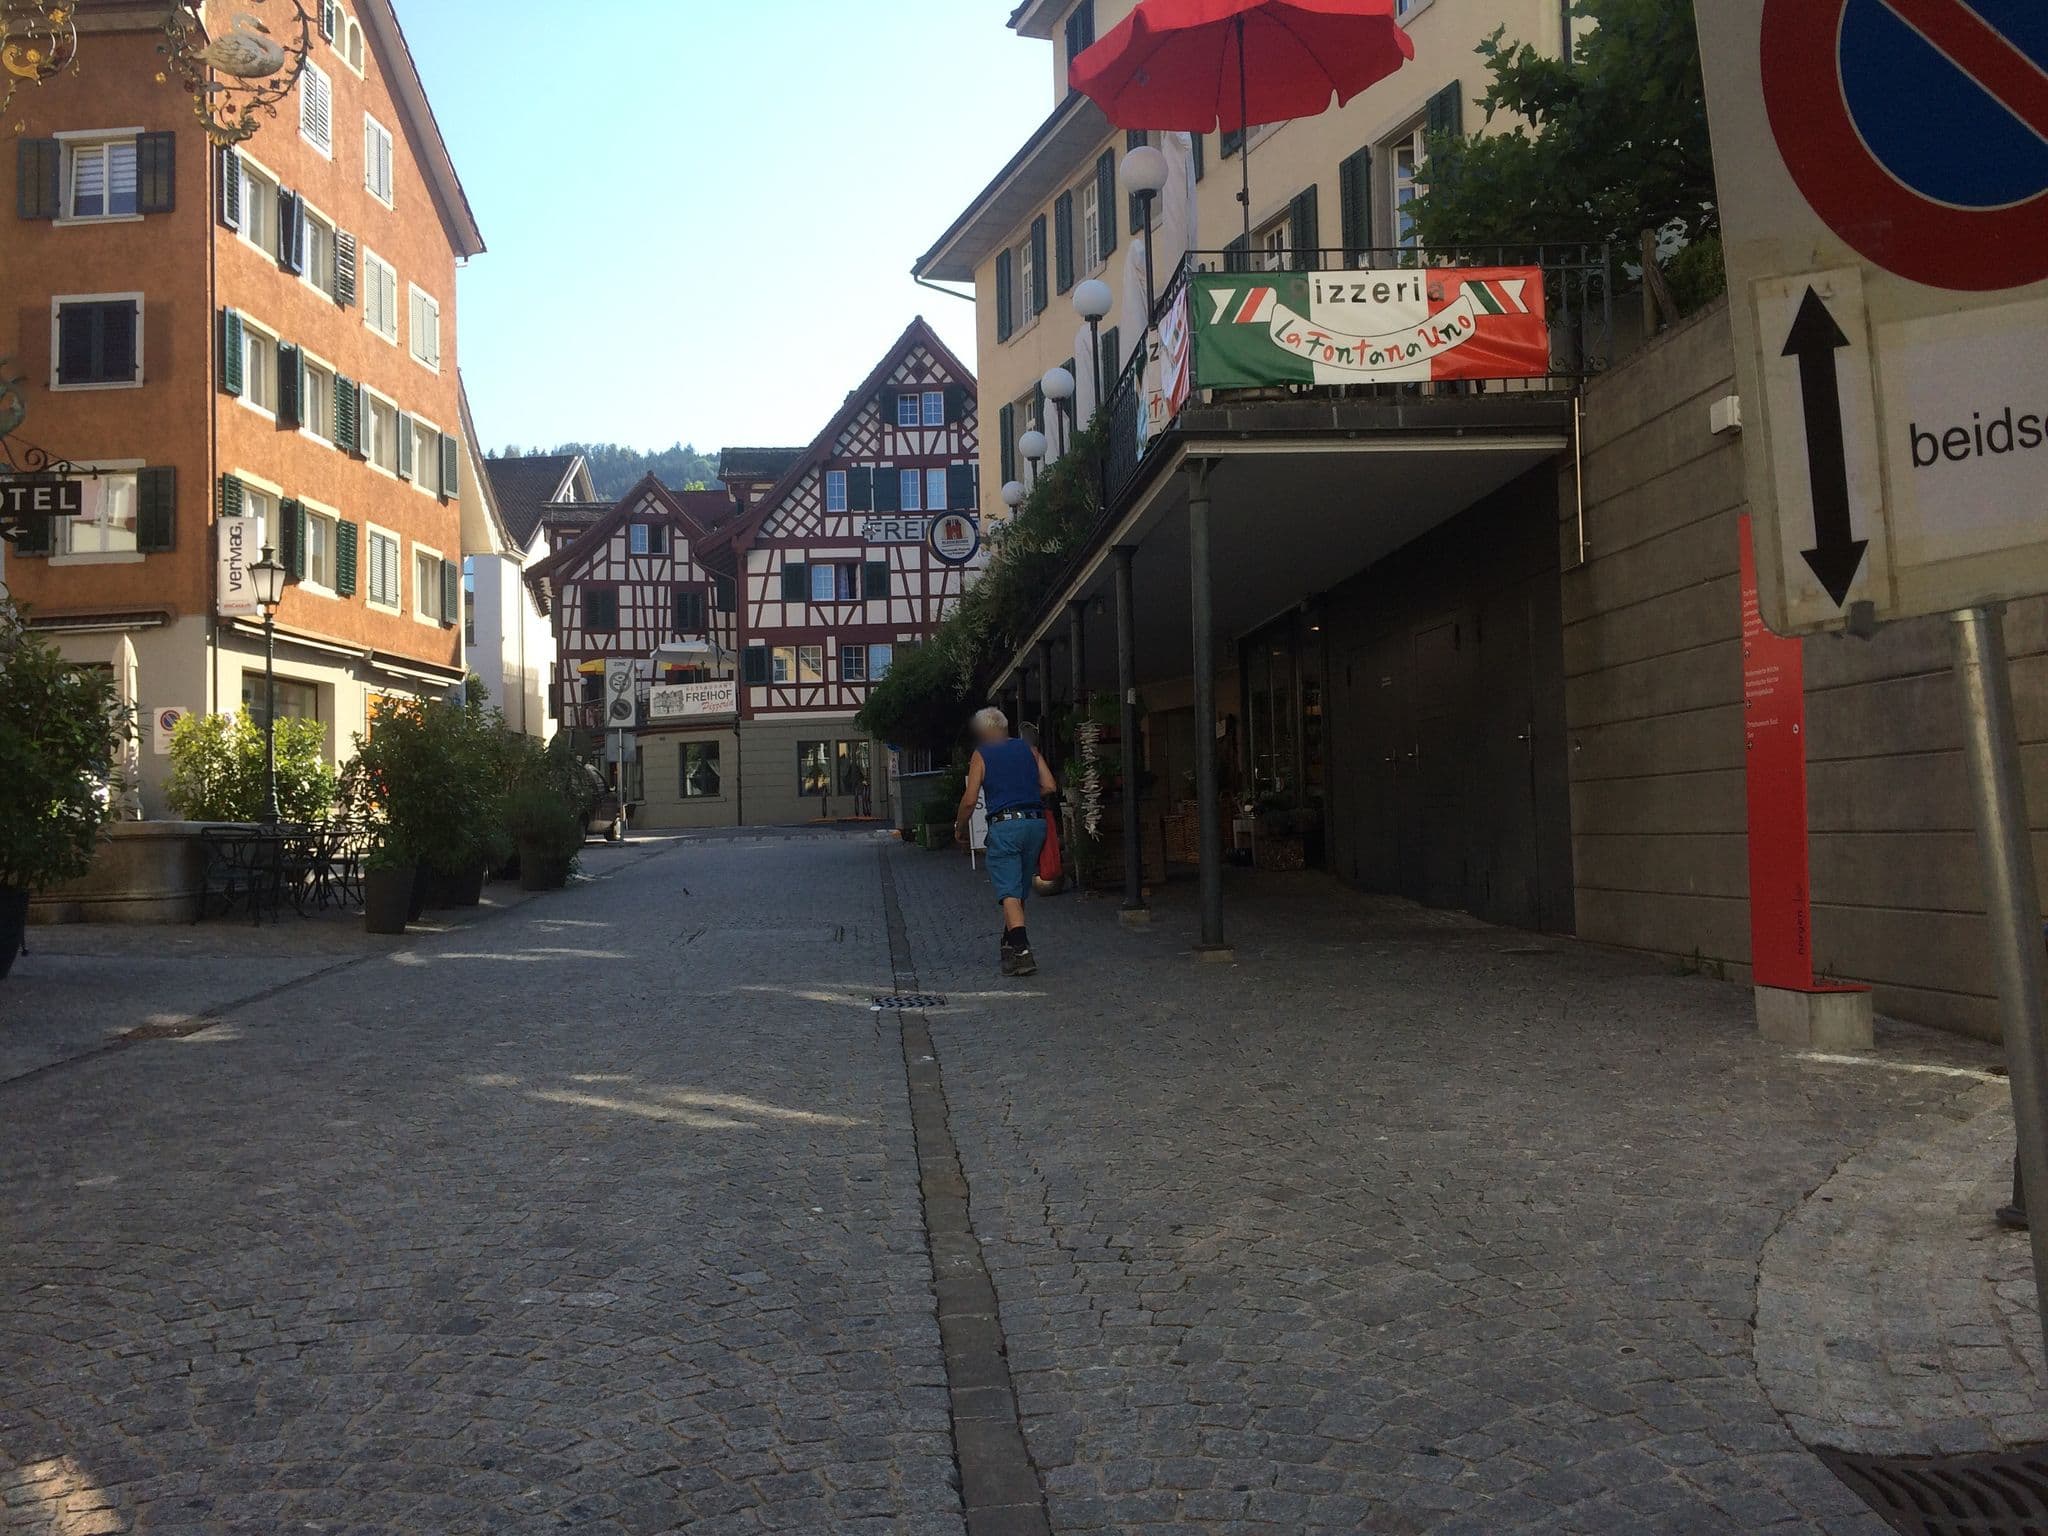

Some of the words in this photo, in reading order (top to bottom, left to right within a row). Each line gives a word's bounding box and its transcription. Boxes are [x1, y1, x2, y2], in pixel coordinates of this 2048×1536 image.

[1290, 276, 1444, 304] izzeria
[1275, 319, 1302, 348] La
[1306, 331, 1421, 366] Fontana
[1417, 315, 1472, 349] Uno
[1909, 406, 2048, 468] beids
[0, 487, 77, 511] TEL
[868, 521, 926, 540] FREI
[685, 689, 733, 702] FREIHOF
